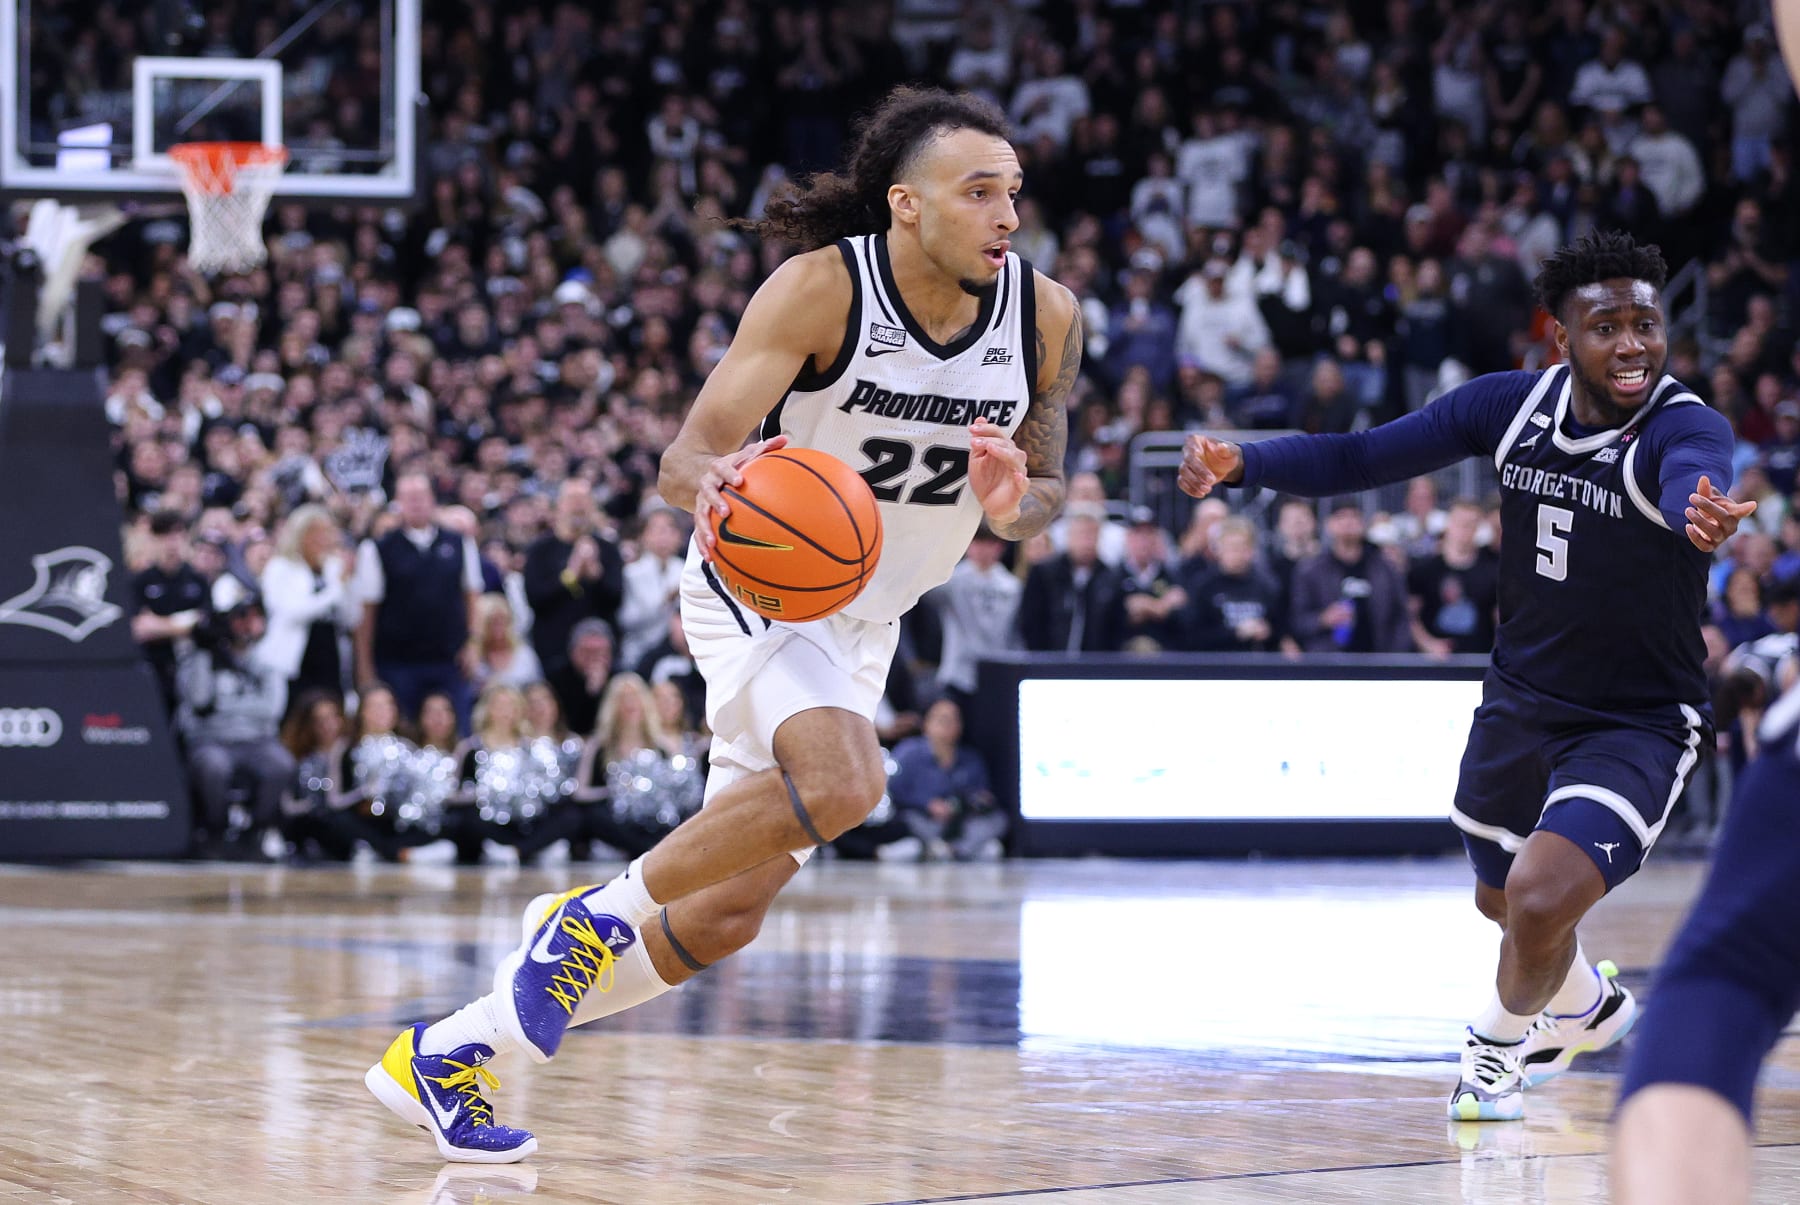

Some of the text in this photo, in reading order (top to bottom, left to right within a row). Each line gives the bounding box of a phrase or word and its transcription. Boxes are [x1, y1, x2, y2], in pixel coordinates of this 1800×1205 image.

[982, 355, 1013, 363] EAST
[986, 347, 1007, 355] BIG
[838, 378, 1018, 427] PROVIDENCE
[857, 436, 972, 507] 22
[1502, 463, 1624, 519] GEORGETOWN
[1536, 503, 1574, 582] 5
